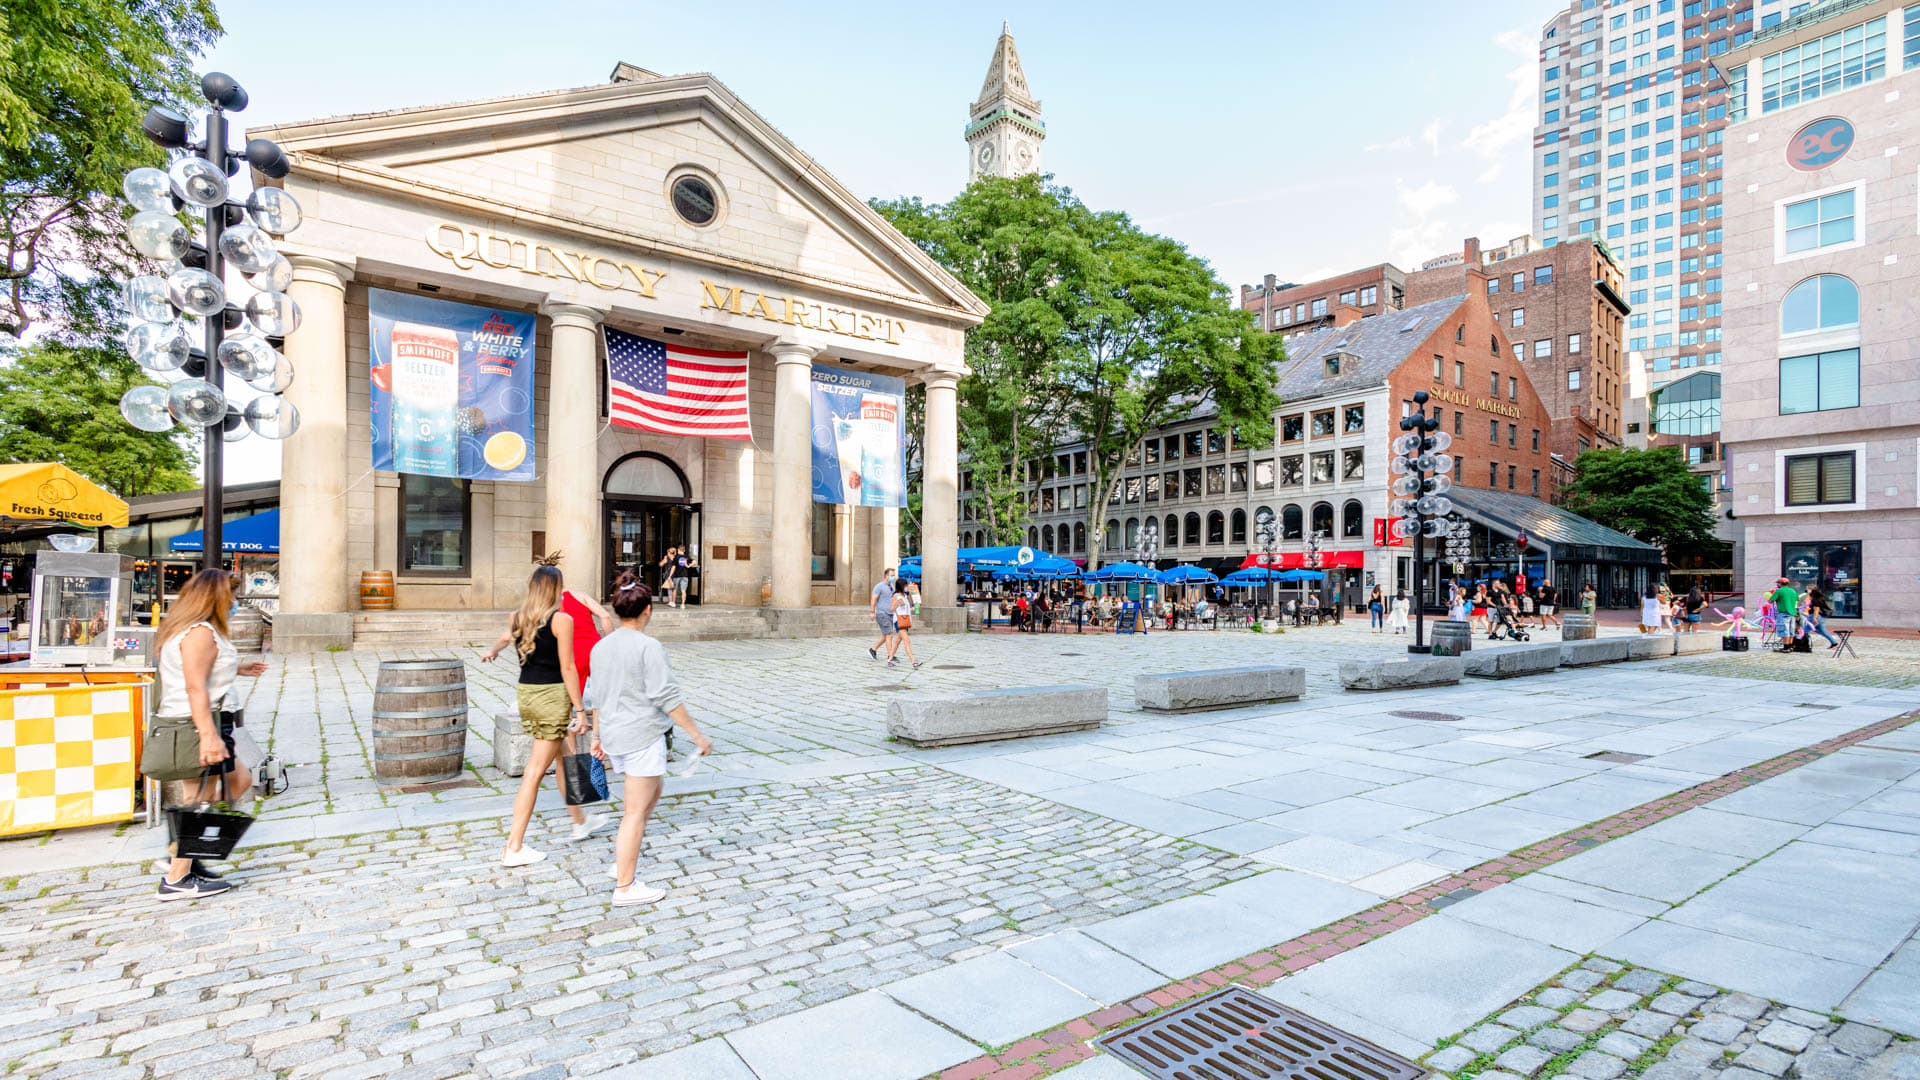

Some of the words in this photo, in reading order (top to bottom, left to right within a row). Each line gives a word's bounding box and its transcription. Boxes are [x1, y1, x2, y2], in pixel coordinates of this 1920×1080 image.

[1795, 126, 1846, 160] ec
[425, 223, 668, 299] QUINCY
[700, 279, 906, 345] MARKET
[483, 321, 514, 335] RED
[472, 330, 524, 347] WHITE
[399, 343, 451, 361] SMIRNOFF
[462, 340, 475, 352] &
[478, 343, 529, 359] BERRY
[812, 371, 838, 383] ZERO
[840, 375, 872, 388] SUGAR
[816, 383, 858, 397] SELTZER
[1430, 386, 1470, 407] SOUTH
[1476, 397, 1521, 420] MARKET
[12, 503, 45, 516] Fresh
[48, 507, 103, 522] Squeezed
[240, 542, 263, 550] DOG
